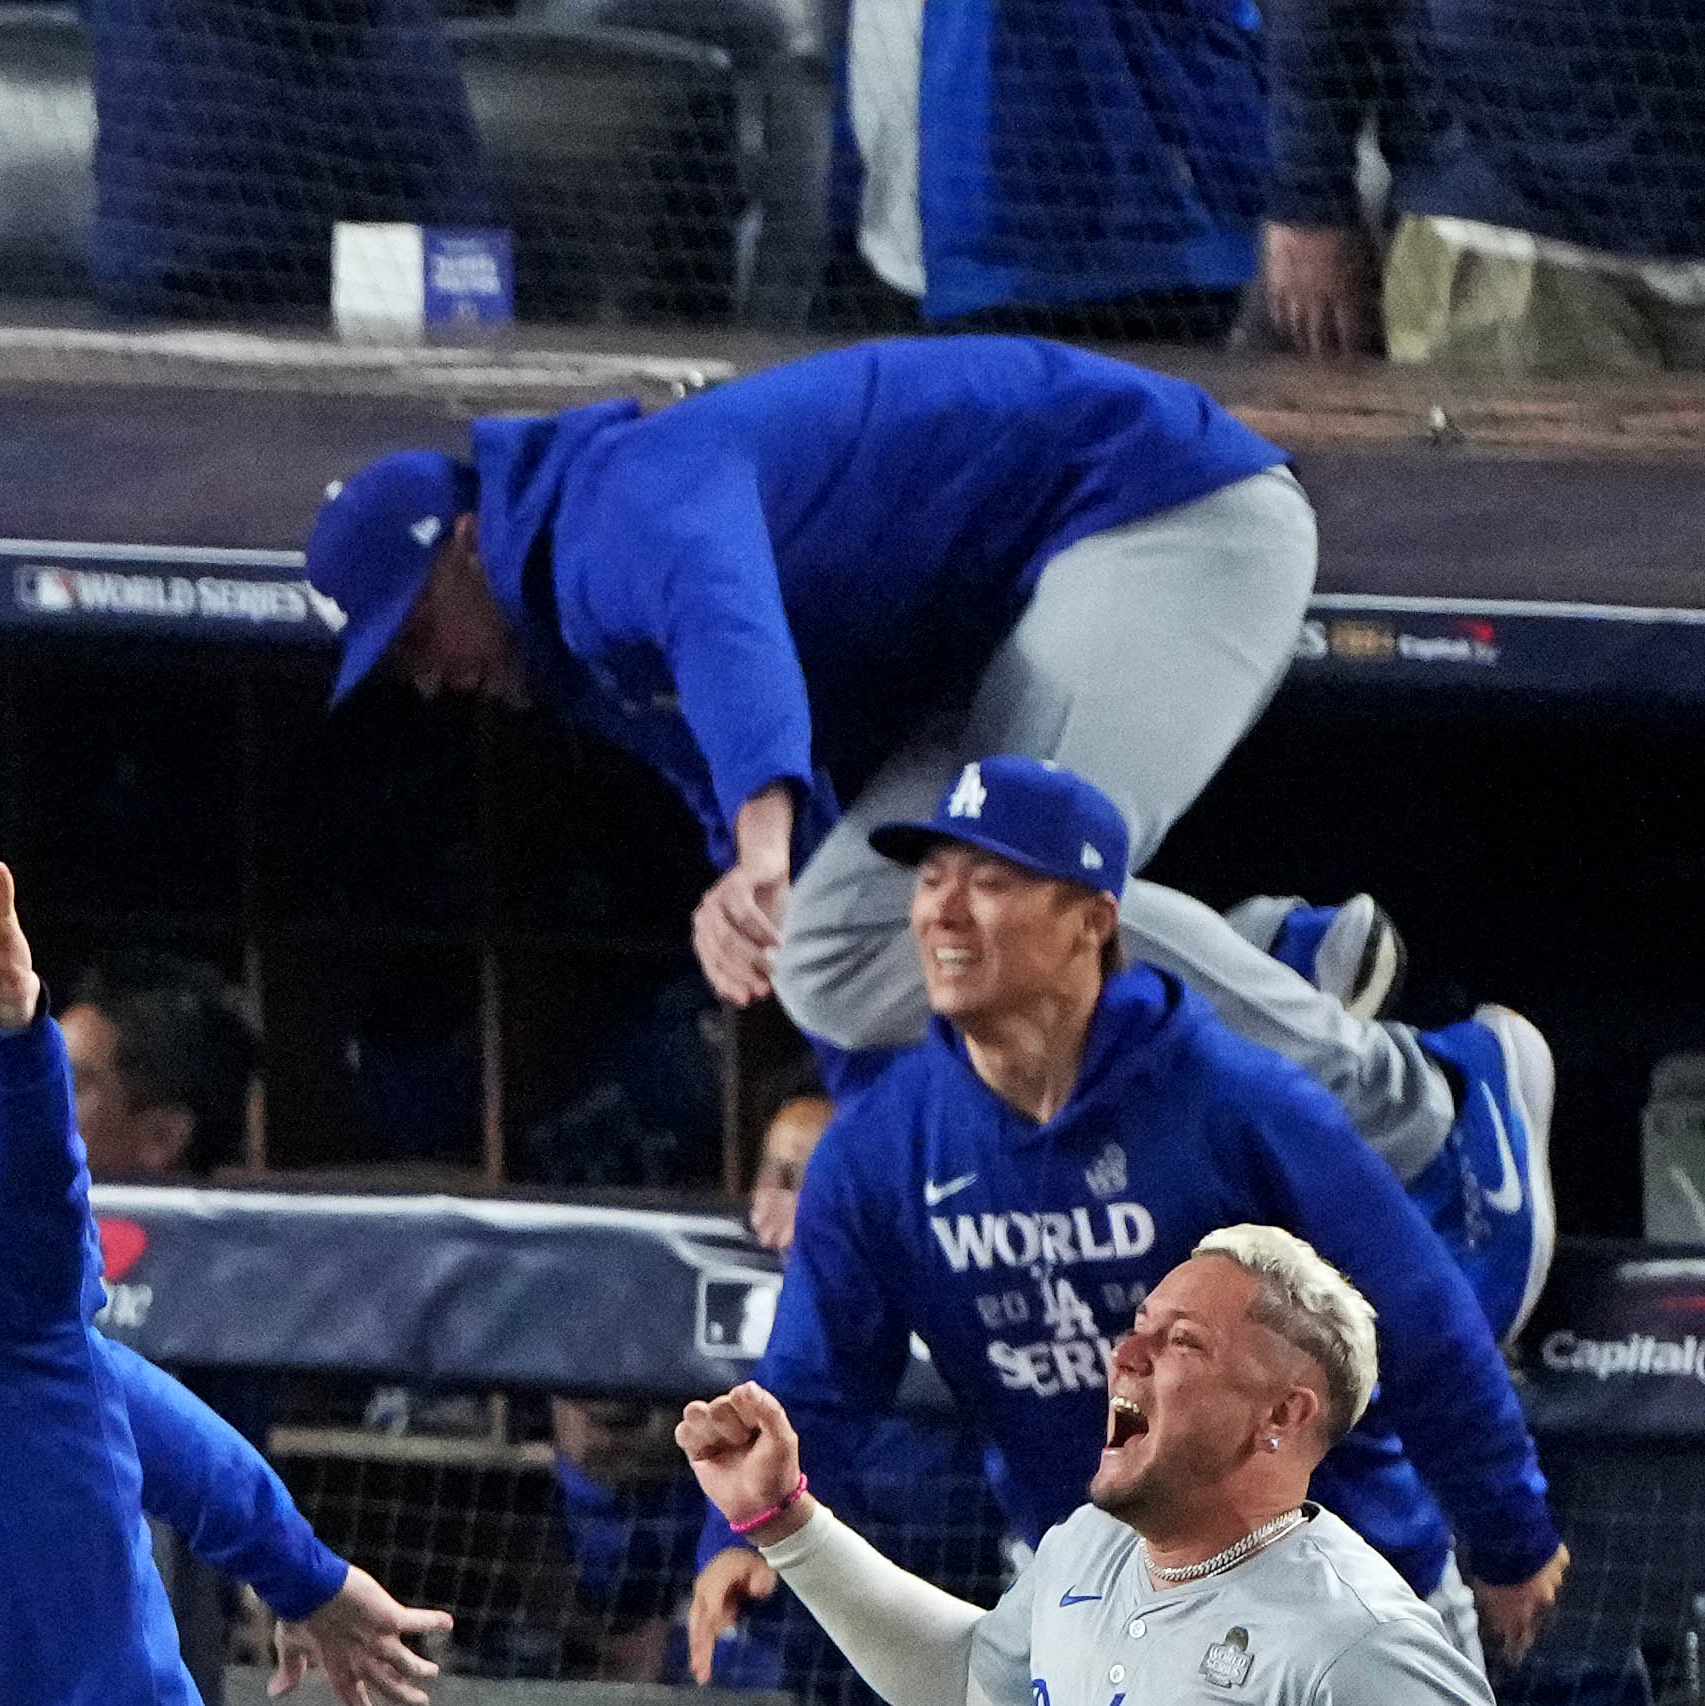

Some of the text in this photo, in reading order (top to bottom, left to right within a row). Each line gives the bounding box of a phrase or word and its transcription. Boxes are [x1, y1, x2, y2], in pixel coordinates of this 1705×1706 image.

[930, 1202, 1156, 1273] WORLD
[986, 1337, 1113, 1398] SERI
[1542, 1330, 1705, 1383] Capital
